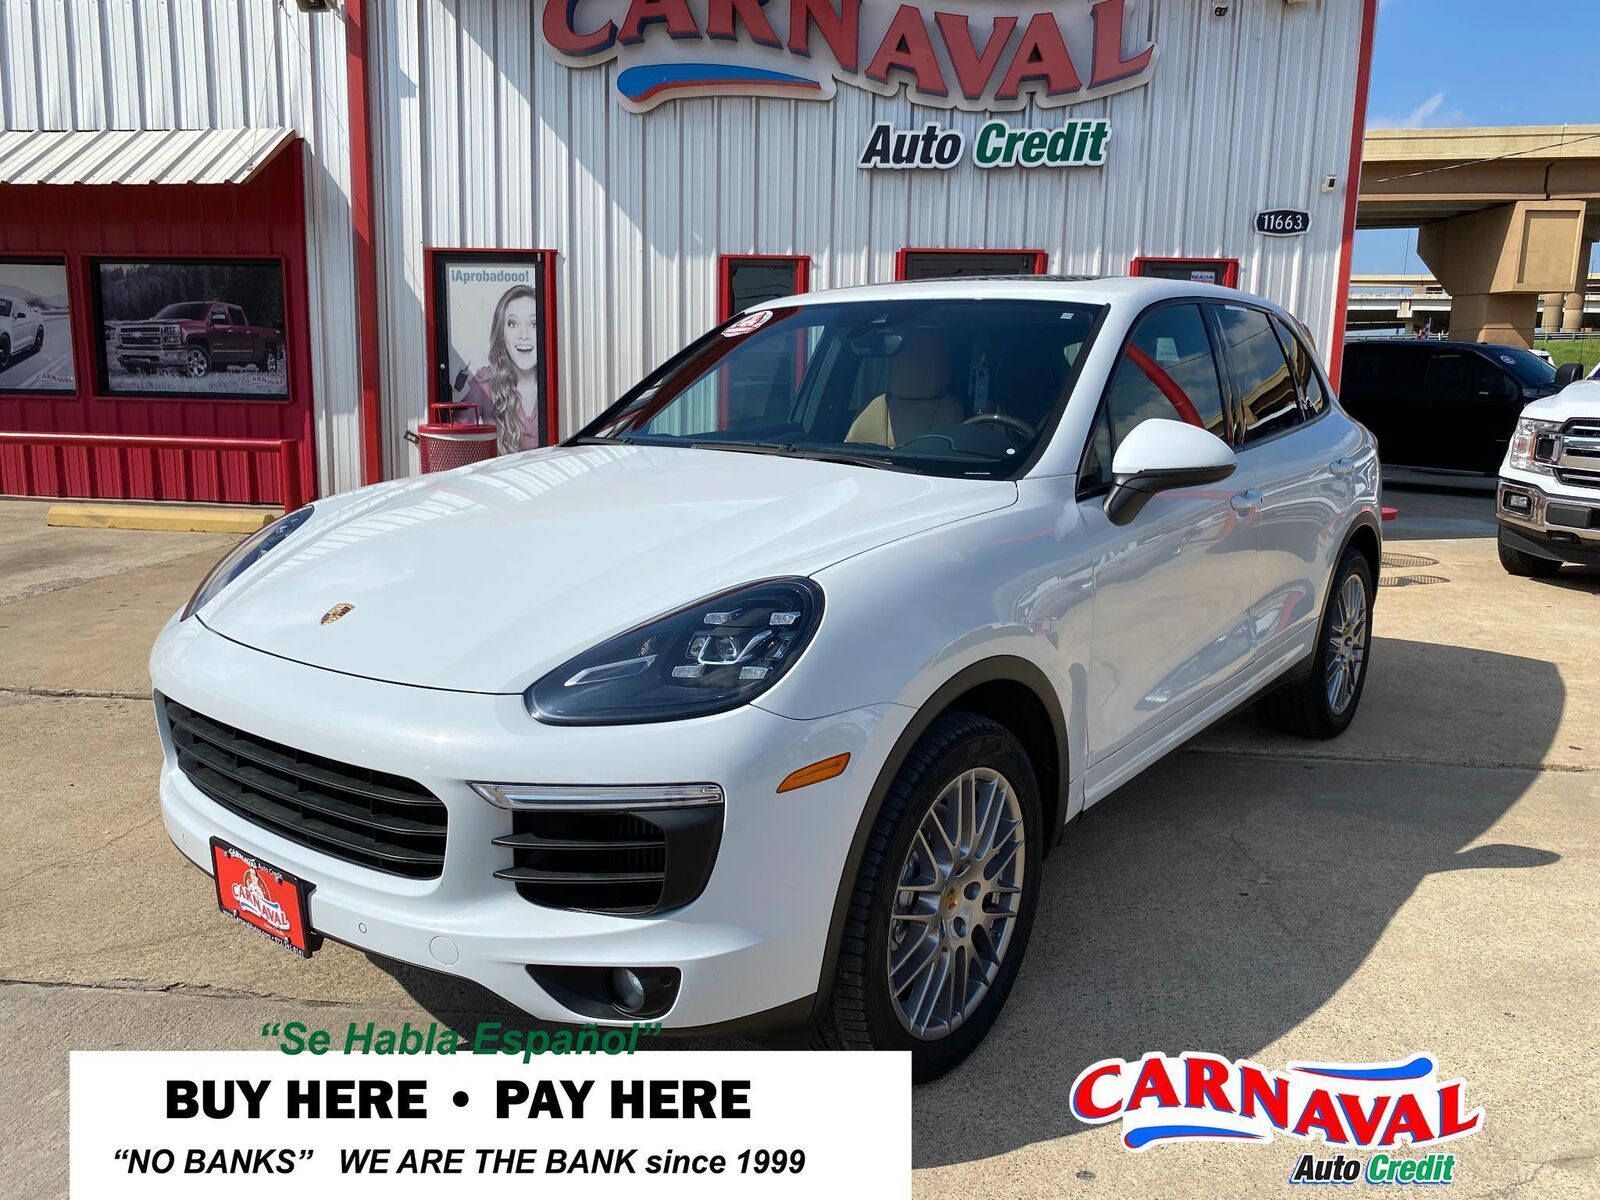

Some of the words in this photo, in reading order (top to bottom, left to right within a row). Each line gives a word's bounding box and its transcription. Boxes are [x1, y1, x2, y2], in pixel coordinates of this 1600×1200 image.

[542, 0, 1155, 101] CARNAVAL
[861, 125, 961, 164] Auto
[975, 121, 1108, 163] Credit
[1263, 214, 1303, 230] 11663
[451, 269, 529, 284] ¡Aprobadooo!
[232, 883, 288, 926] CARNAVAL
